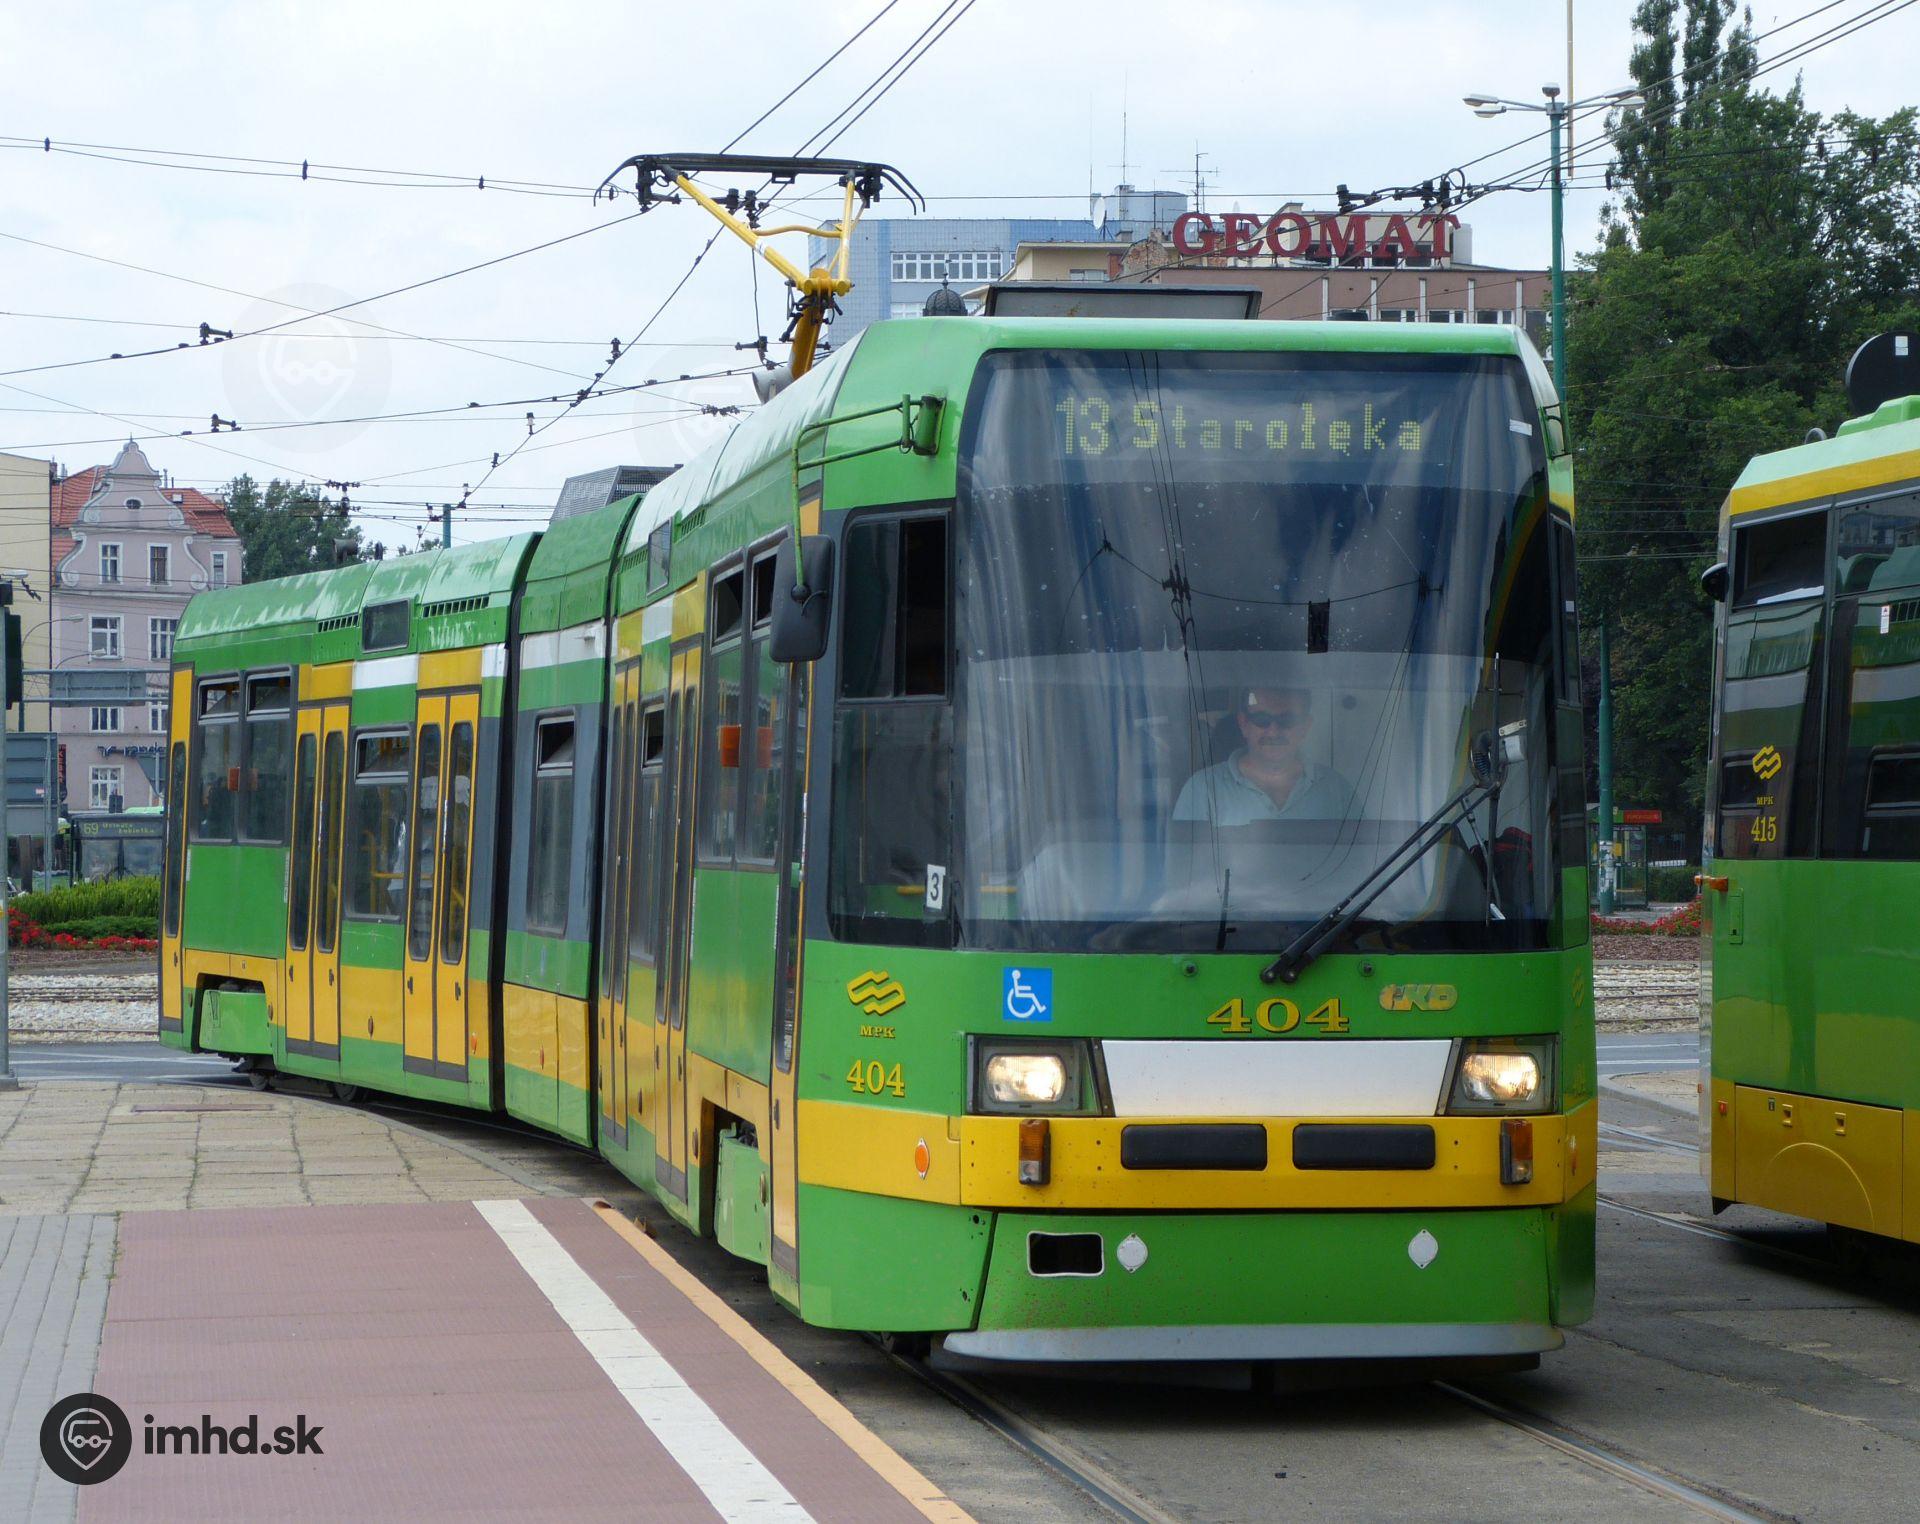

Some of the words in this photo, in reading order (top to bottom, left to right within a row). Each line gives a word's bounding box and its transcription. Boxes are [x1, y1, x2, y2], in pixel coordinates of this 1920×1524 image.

[1172, 211, 1461, 259] GEOMAT
[1055, 396, 1111, 455] 13
[1131, 399, 1423, 457] Starołęka
[1755, 795, 1774, 806] MPK
[83, 822, 99, 836] 69
[1750, 816, 1777, 843] 415
[929, 871, 941, 902] 3
[1206, 998, 1351, 1034] 404
[859, 1024, 897, 1040] MPK
[846, 1059, 906, 1098] 404
